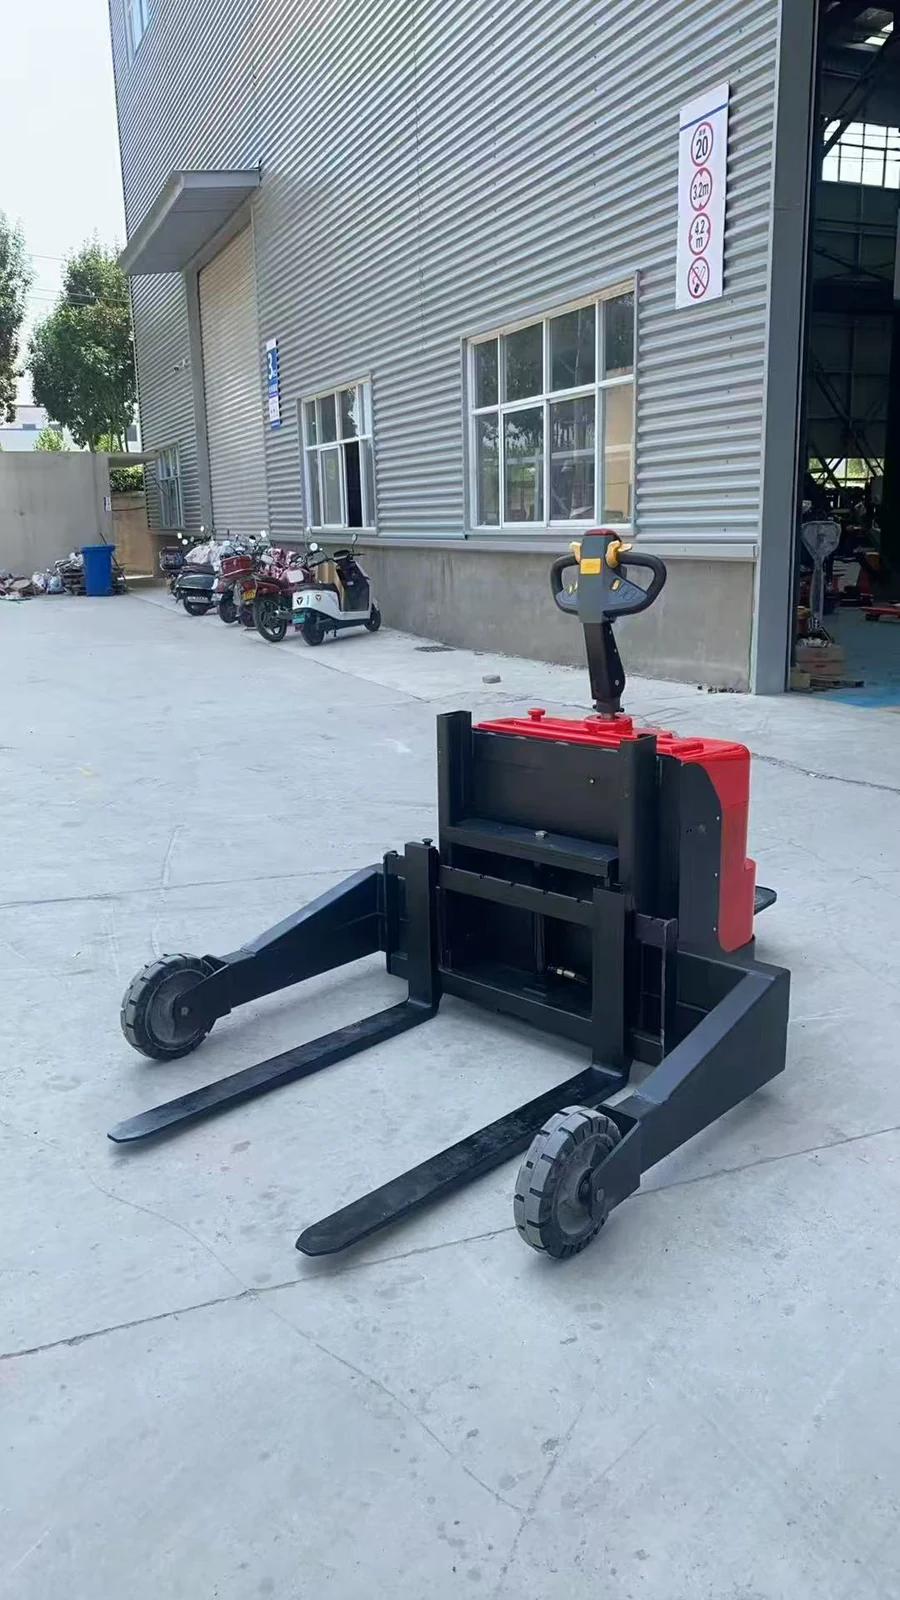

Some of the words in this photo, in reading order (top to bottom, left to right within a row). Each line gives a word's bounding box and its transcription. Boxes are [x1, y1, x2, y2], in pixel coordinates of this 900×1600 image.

[695, 135, 708, 160] 20
[693, 181, 709, 201] 3.2m
[695, 236, 703, 249] m
[268, 352, 274, 380] 3
